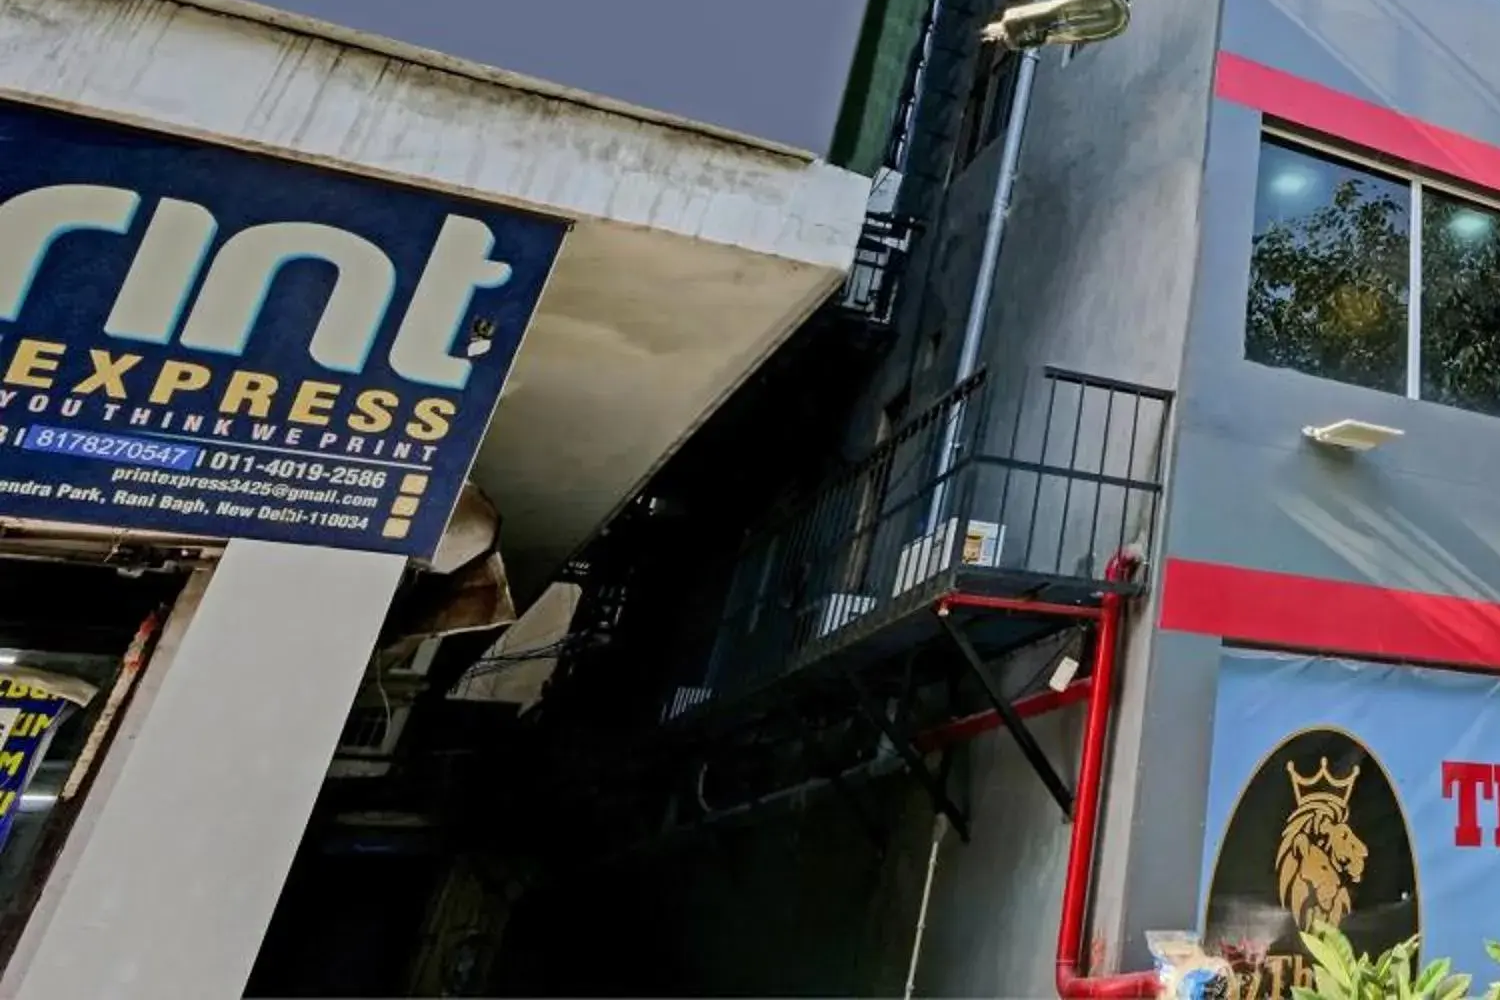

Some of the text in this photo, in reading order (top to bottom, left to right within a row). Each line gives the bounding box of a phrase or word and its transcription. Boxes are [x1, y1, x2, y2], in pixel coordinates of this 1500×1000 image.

[4, 338, 456, 441] EXPRESS
[0, 389, 437, 462] YOU THINK WE PRINT
[36, 429, 187, 465] 8178270547
[210, 451, 387, 488] 011-4019-2586
[112, 467, 378, 508] printexpress3425@gmail.com
[57, 483, 106, 504] Park,
[113, 489, 156, 507] Rani
[159, 494, 209, 515] Bagh,
[216, 501, 253, 520] New
[258, 505, 369, 531] Delhi-110034
